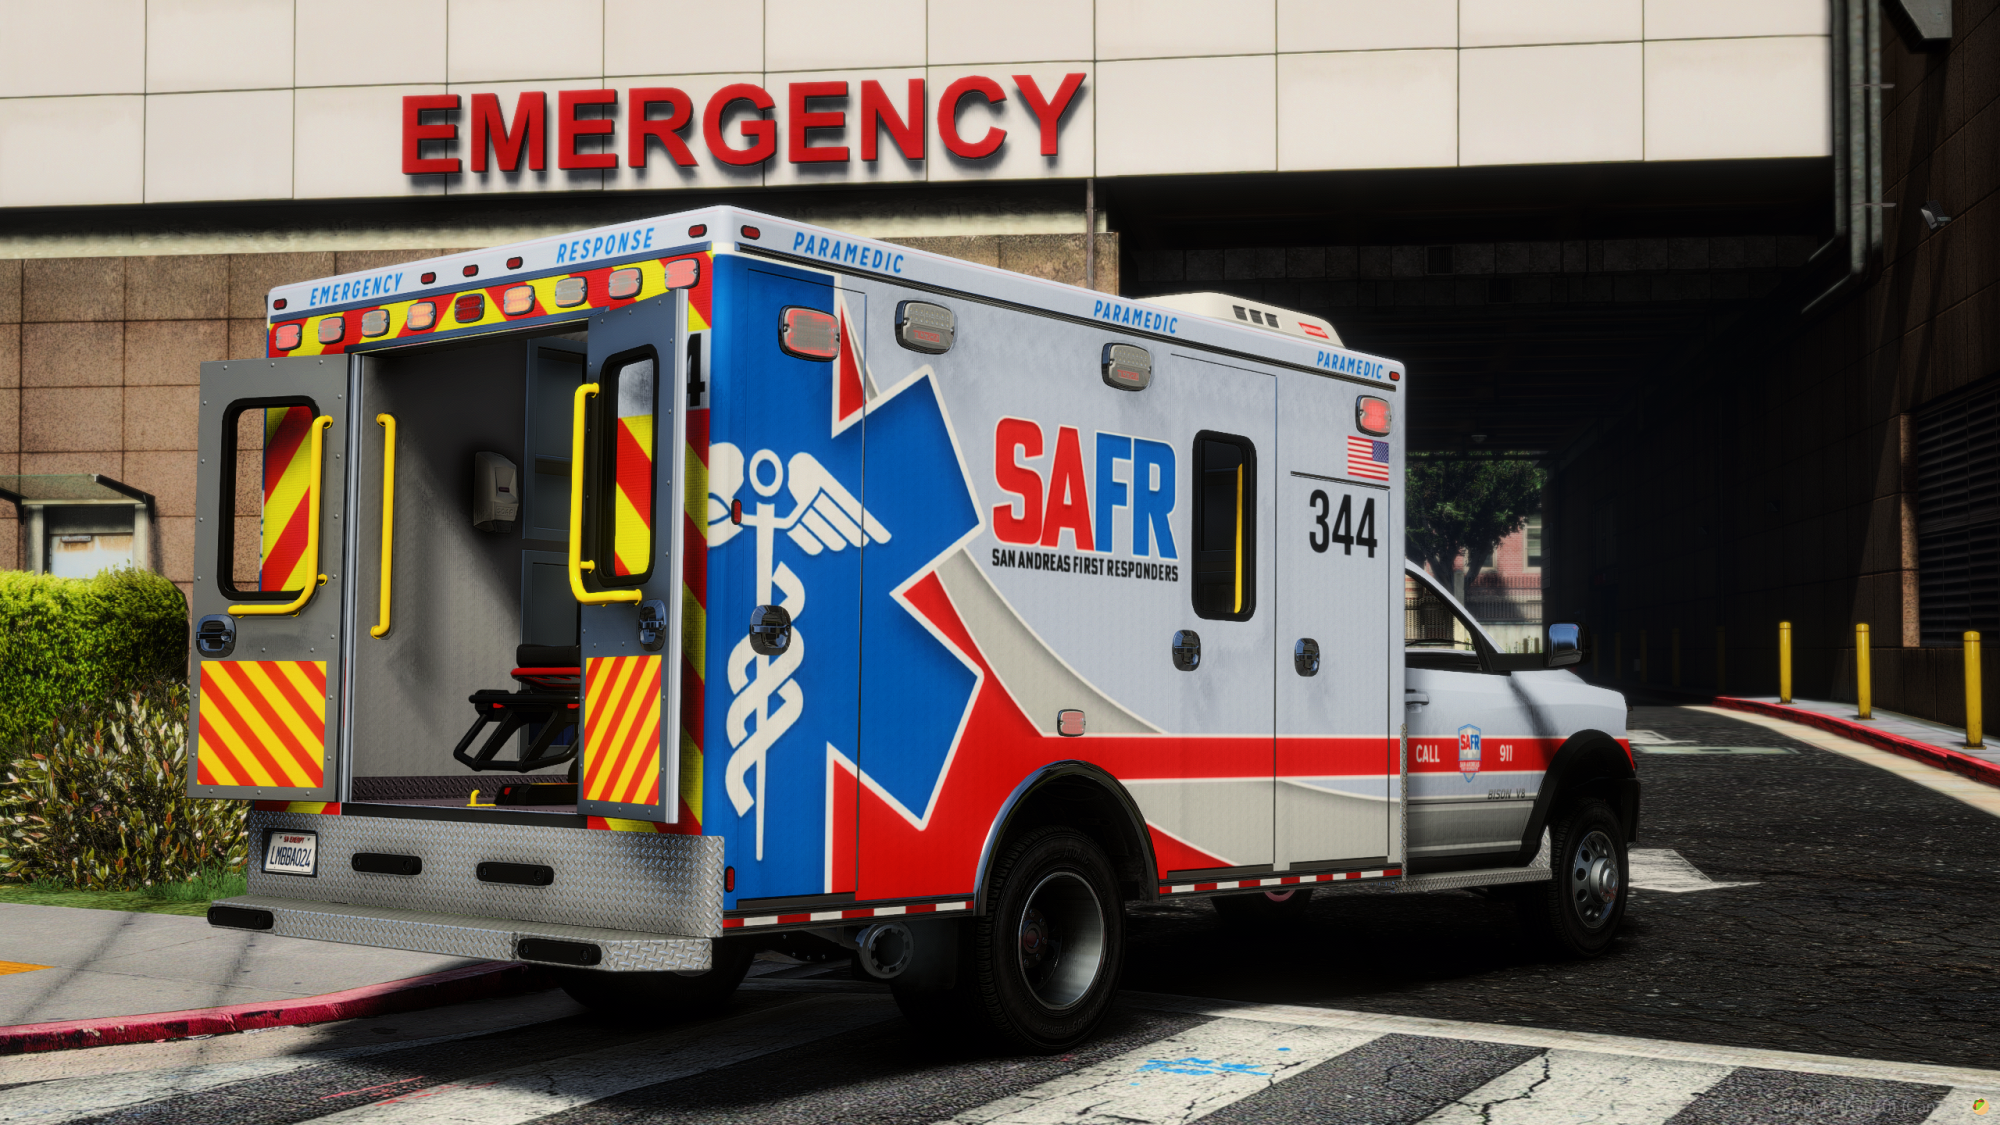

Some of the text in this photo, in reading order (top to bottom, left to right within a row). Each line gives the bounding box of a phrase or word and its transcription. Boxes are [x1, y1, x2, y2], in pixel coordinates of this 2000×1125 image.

[402, 72, 1088, 174] EMERGENCY
[309, 227, 655, 307] EMERGENCY RESPONSE
[793, 231, 904, 274] PARAMEDIC
[1094, 300, 1178, 334] PARAMEDIC
[1317, 350, 1384, 380] PARAMEDIC
[992, 415, 1179, 563] SAFR
[1309, 489, 1378, 558] 344
[992, 548, 1179, 583] SAN ANDREAS FIRST RESPONDERS
[1416, 734, 1513, 762] CALL SAFR 911
[1487, 787, 1526, 800] BISON V8
